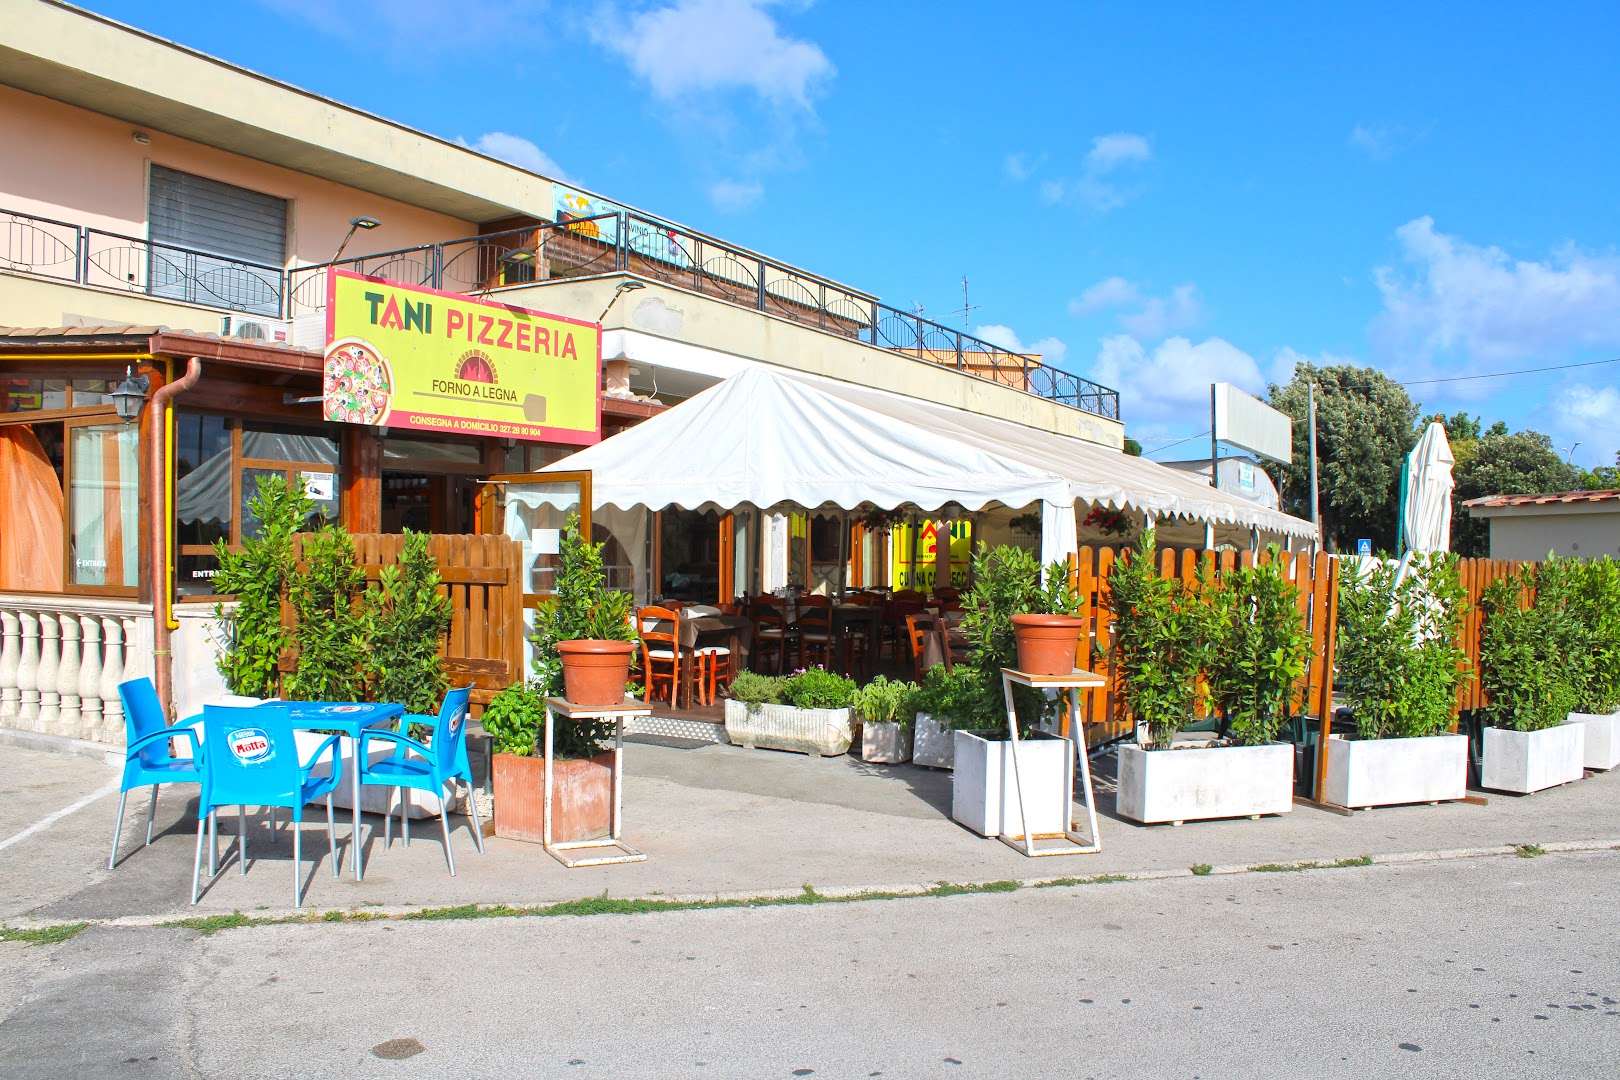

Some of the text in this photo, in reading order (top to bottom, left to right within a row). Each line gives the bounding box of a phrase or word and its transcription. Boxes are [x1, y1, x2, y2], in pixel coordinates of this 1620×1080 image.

[365, 291, 578, 360] TANI PIZZERIA
[432, 379, 517, 402] FORNO A LEGNA
[409, 415, 452, 428] CONSEGNA
[454, 421, 460, 429] A
[460, 421, 498, 433] DOMICILIO
[521, 428, 529, 436] 90
[530, 428, 541, 437] 904
[82, 559, 107, 567] ENTRATA
[236, 741, 266, 753] Motta
